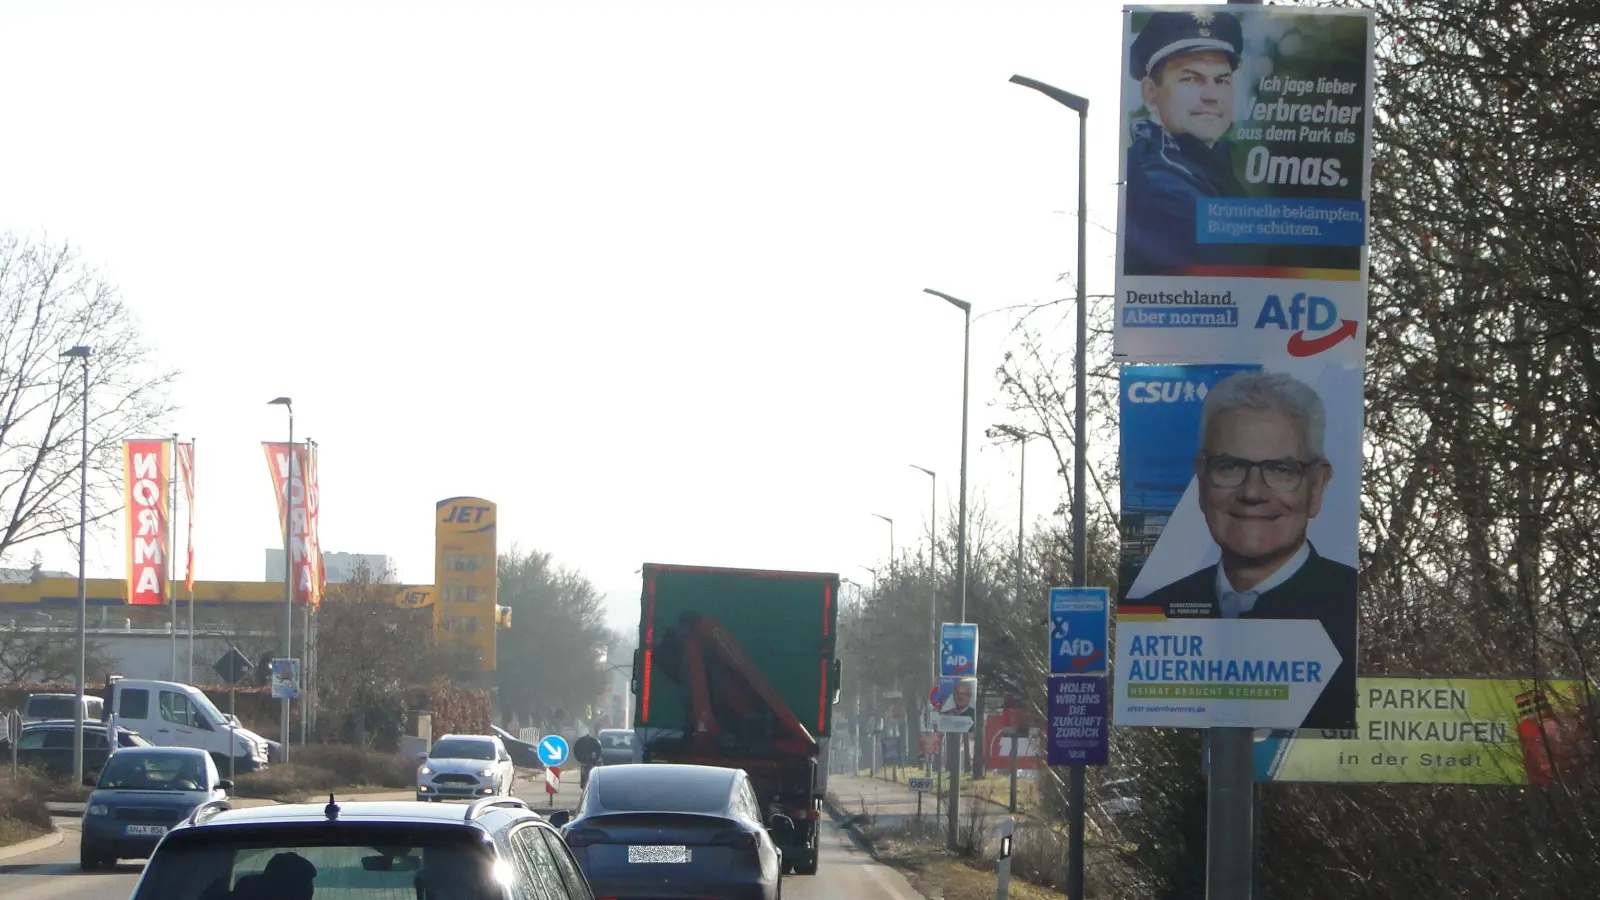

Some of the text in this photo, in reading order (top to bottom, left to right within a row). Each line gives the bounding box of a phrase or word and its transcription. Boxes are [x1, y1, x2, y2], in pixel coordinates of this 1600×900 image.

[1260, 76, 1357, 96] Ich jage lieber
[1243, 97, 1361, 124] Verbrecher
[1237, 125, 1356, 144] aus dem Park als
[1246, 145, 1348, 187] Omas.
[1208, 204, 1362, 223] Kriminelle bekämpfen,
[1208, 221, 1322, 237] Bürger schützen.
[1126, 290, 1237, 306] Deutschland.
[1124, 310, 1237, 326] Aber normal.
[1254, 292, 1338, 332] AfD
[1128, 381, 1182, 403] CSU
[443, 506, 490, 523] JET
[1060, 638, 1094, 656] AfD
[1129, 635, 1203, 656] ARTUR
[946, 655, 968, 666] AfD
[1128, 660, 1322, 682] AUERNHAMMER
[1060, 682, 1096, 693] HOLEN
[1131, 687, 1169, 696] HEIMAT
[1056, 694, 1100, 704] WIR UNS
[1369, 689, 1465, 709] PARKEN
[1068, 705, 1087, 715] DIE
[1053, 716, 1103, 727] ZUKUNFT
[1369, 721, 1505, 742] EINKAUFEN
[1340, 752, 1482, 767] in der Stadt
